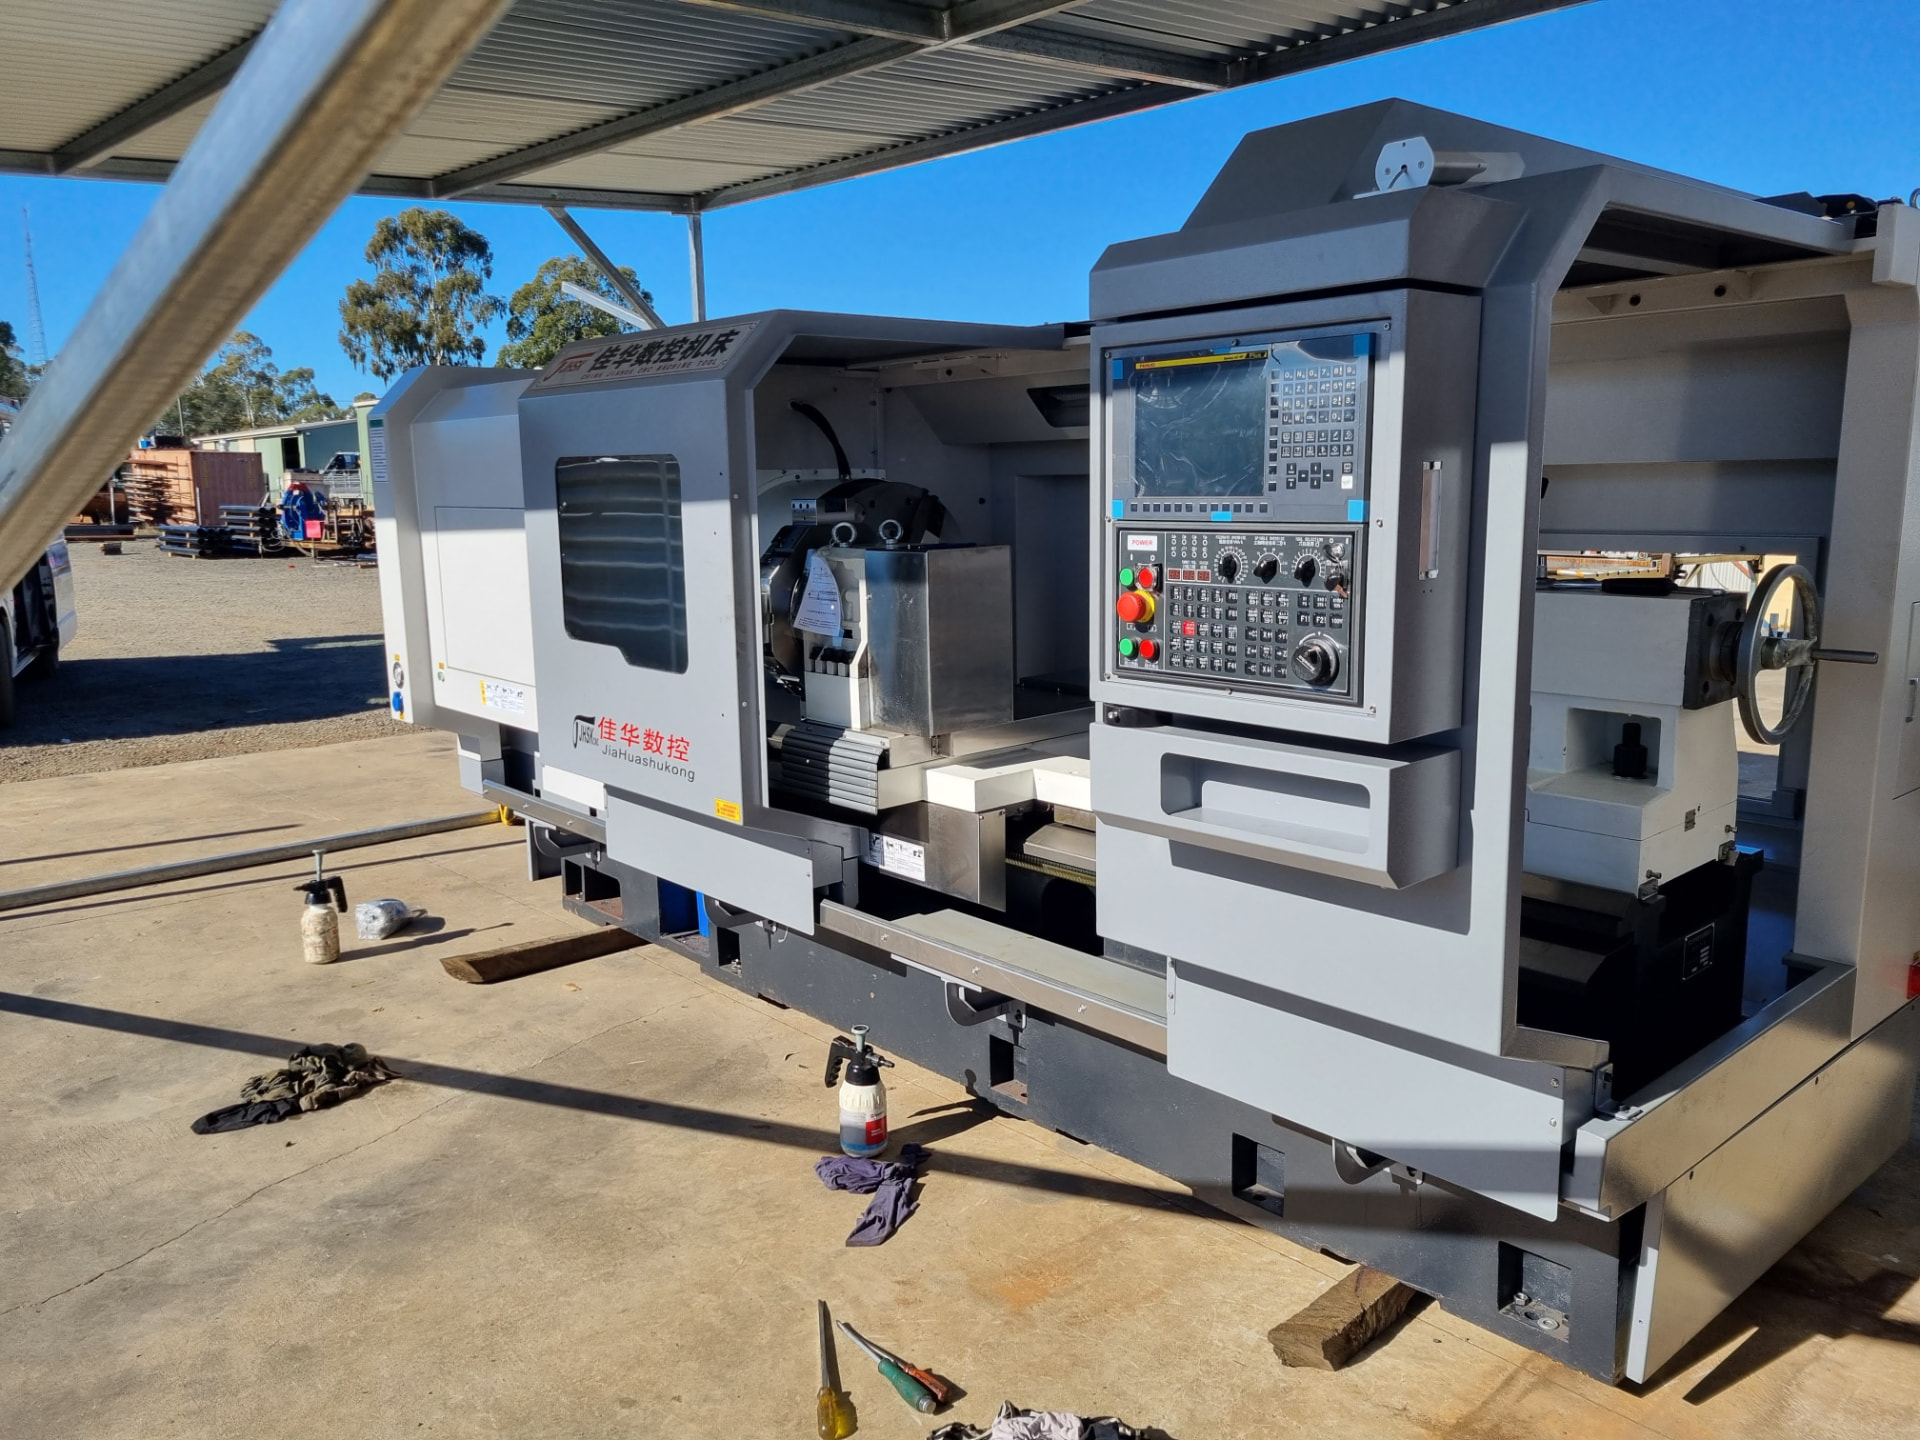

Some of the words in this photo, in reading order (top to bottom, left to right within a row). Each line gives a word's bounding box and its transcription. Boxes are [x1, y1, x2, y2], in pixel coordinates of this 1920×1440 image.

[588, 328, 740, 373] 佳华数控机床
[598, 716, 690, 762] 佳华数控
[602, 745, 695, 782] JiaHuashukong
